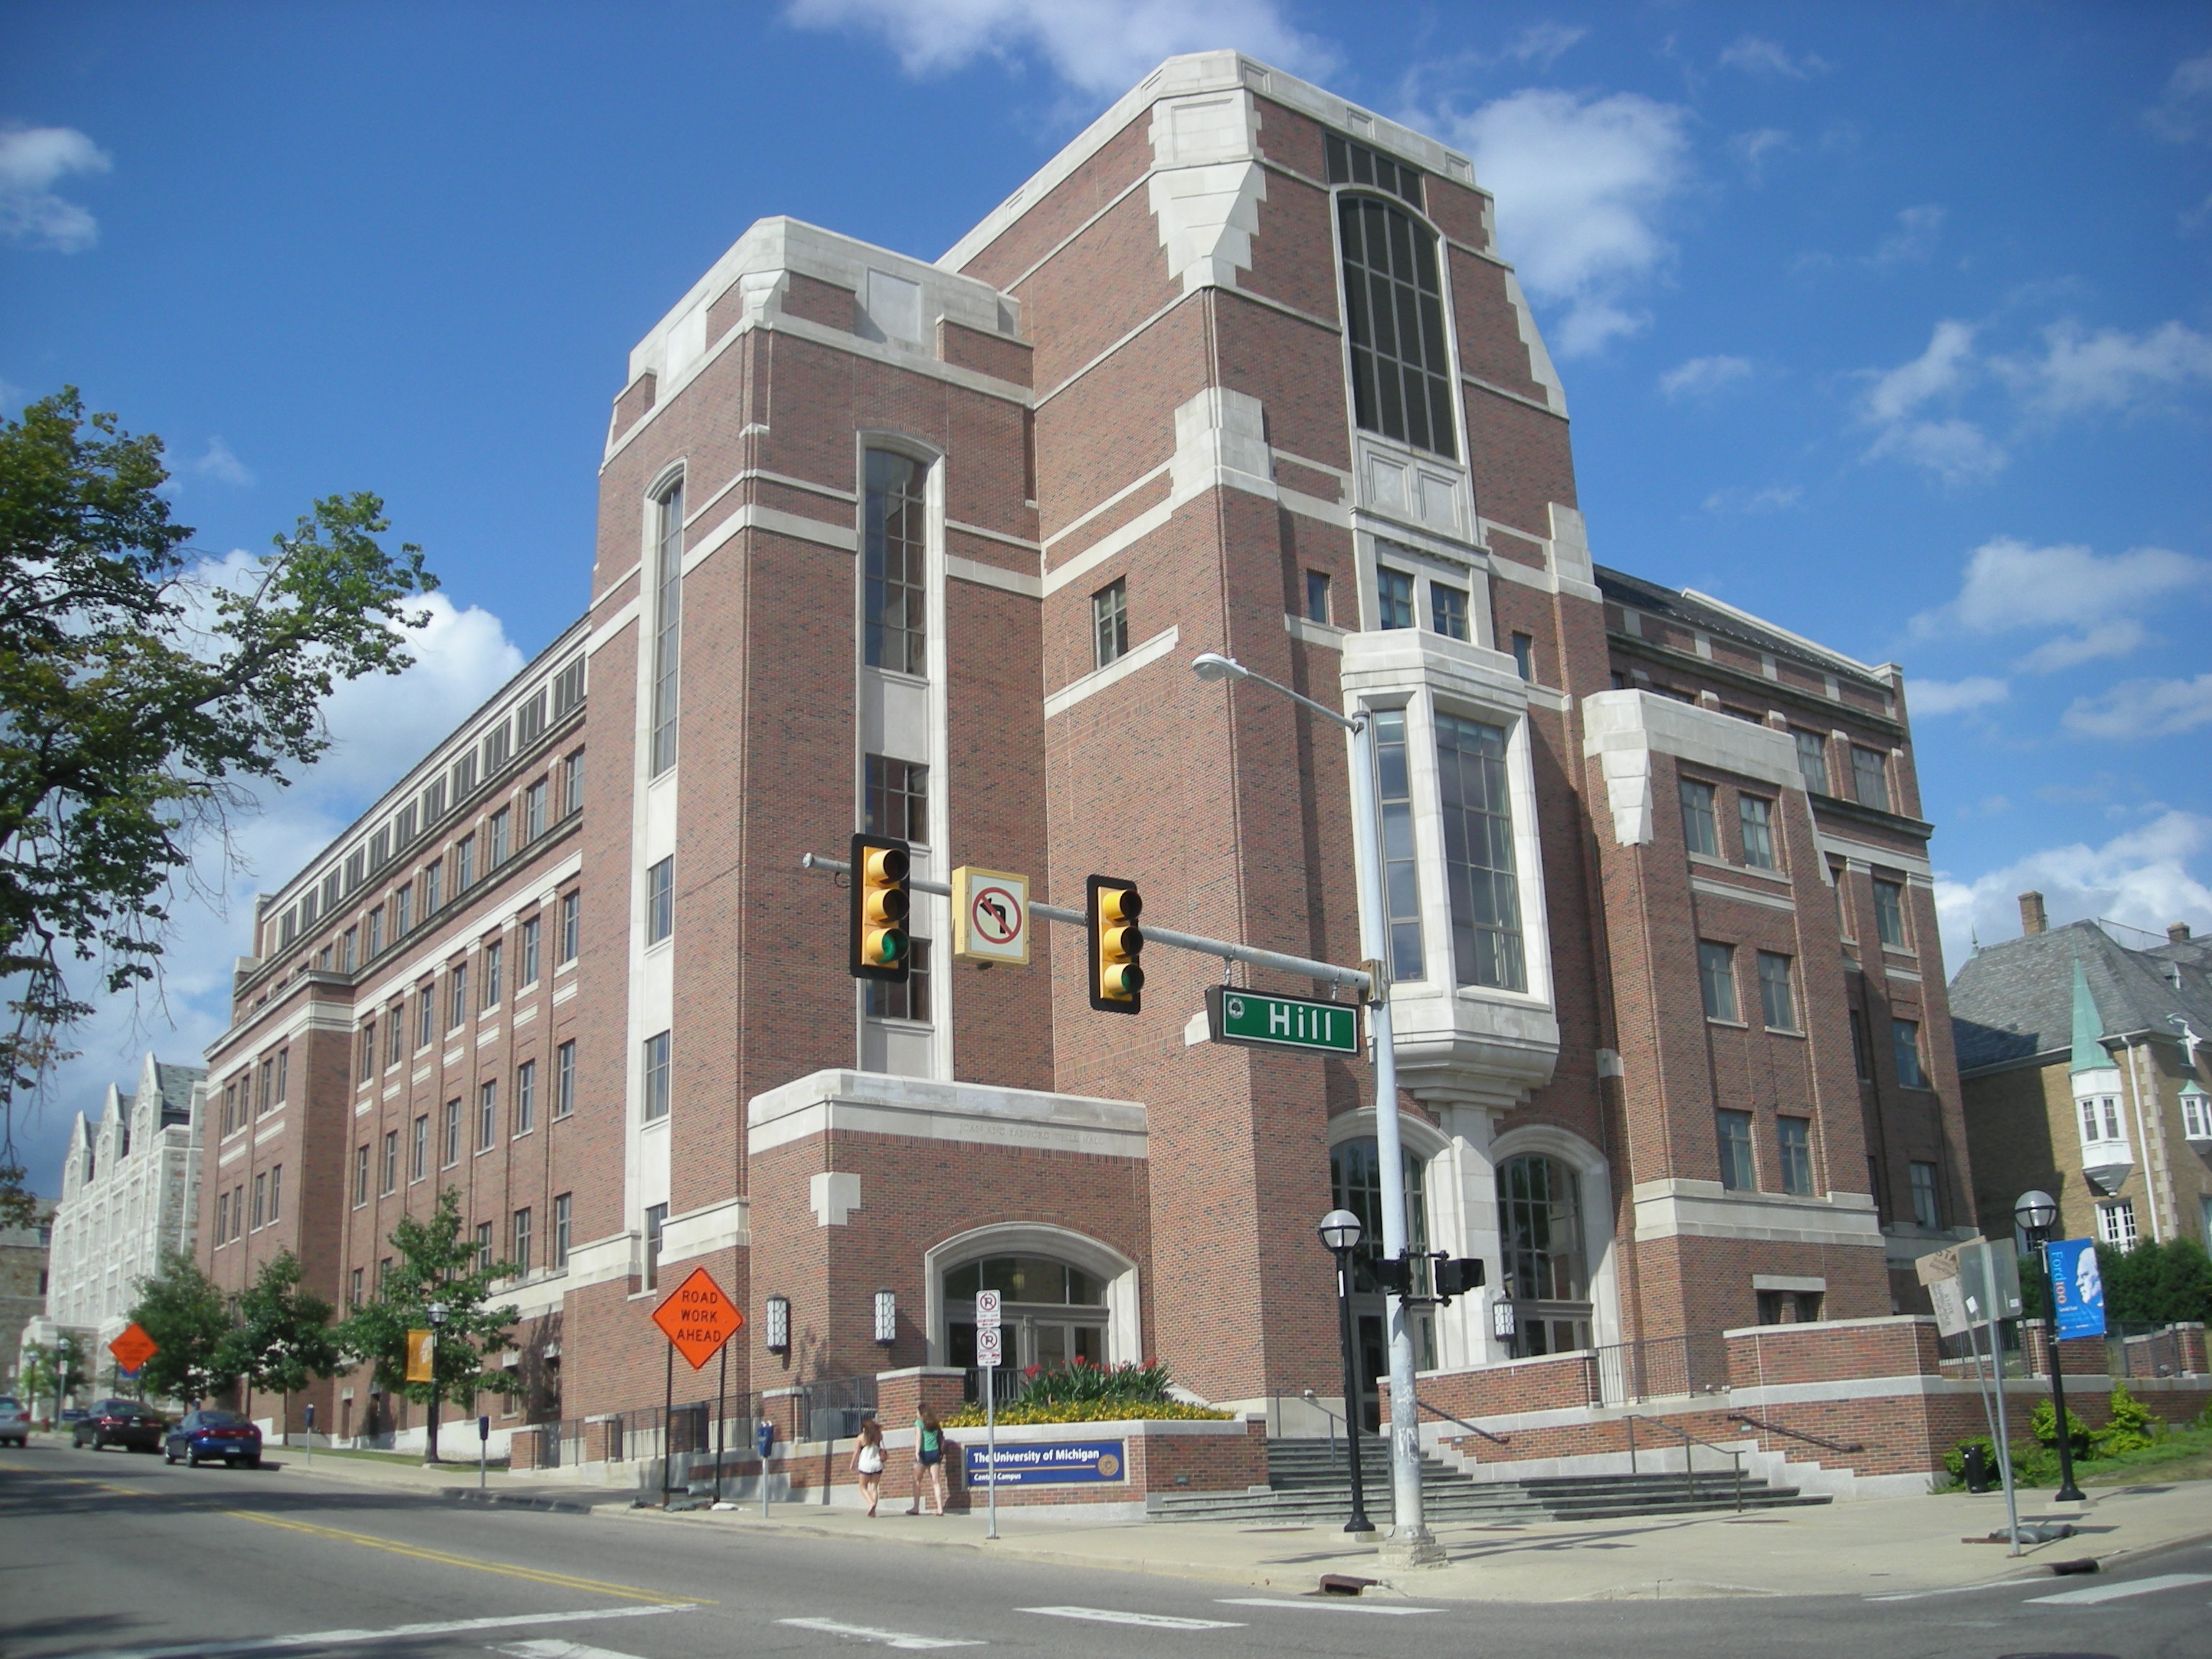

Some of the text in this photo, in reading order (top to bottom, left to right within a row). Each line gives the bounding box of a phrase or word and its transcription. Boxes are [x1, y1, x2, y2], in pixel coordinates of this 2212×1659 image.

[1269, 1002, 1331, 1041] Hill
[682, 1290, 718, 1304] ROAD
[681, 1309, 718, 1323] WORK
[677, 1328, 721, 1343] AHEAD
[974, 1449, 1100, 1463] The University of Michigan
[997, 1473, 1022, 1481] Campus
